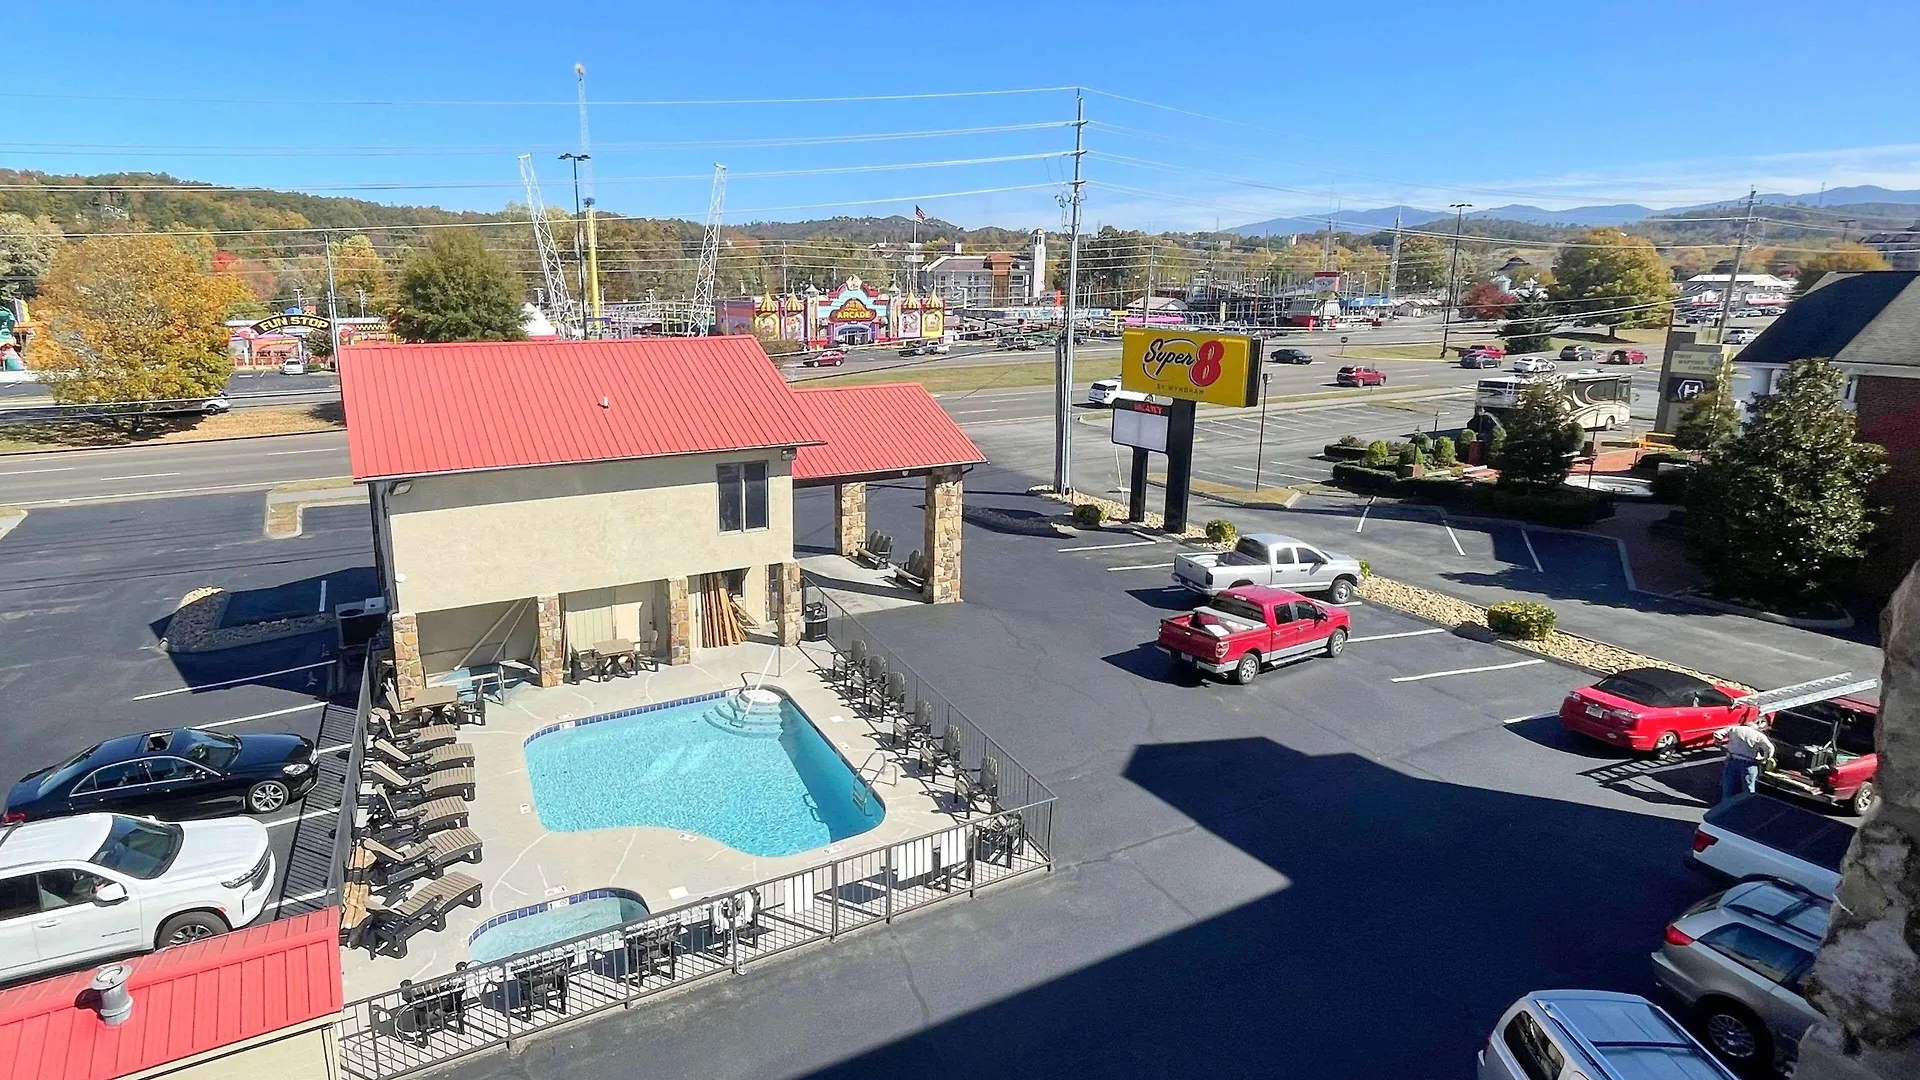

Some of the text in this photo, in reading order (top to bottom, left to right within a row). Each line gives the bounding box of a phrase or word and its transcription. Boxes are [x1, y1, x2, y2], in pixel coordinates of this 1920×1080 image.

[837, 311, 870, 319] ARCADE
[259, 316, 329, 331] FUN STOP
[1143, 338, 1225, 387] Super 8
[1168, 385, 1204, 395] WYNDHAM
